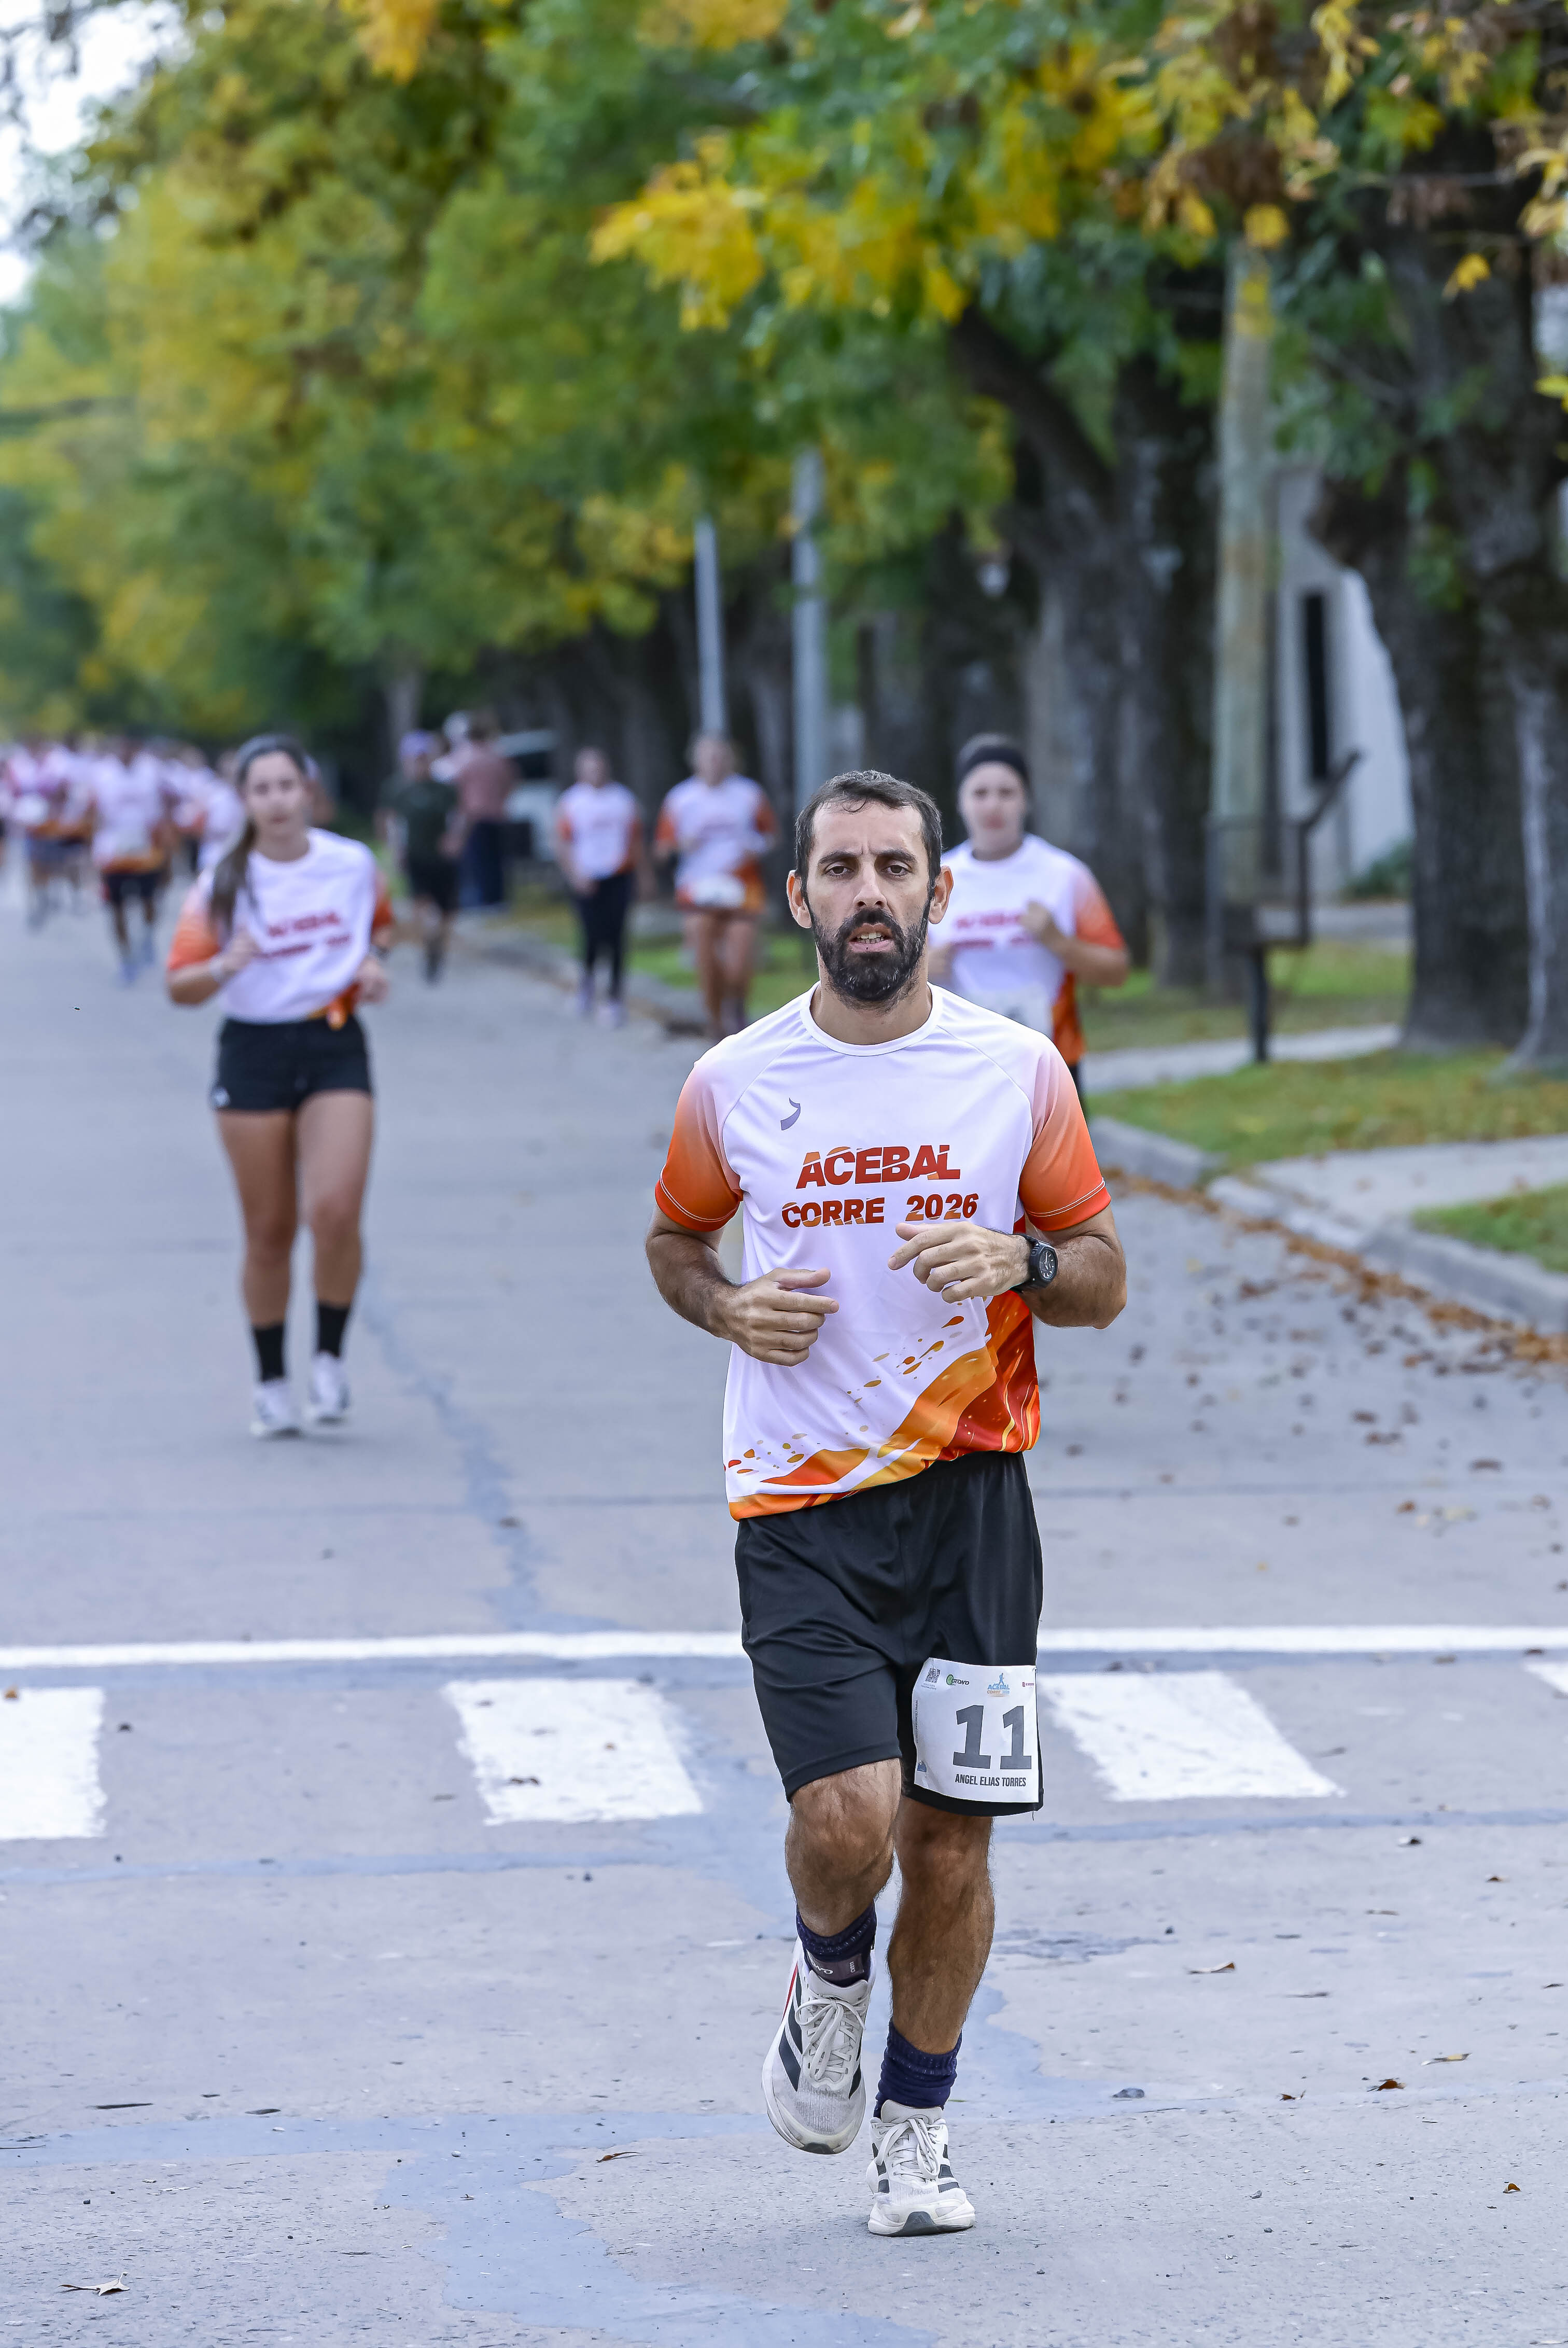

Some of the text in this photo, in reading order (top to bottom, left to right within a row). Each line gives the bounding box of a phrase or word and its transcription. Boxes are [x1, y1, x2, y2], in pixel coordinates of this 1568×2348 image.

[796, 1145, 961, 1189] ACEBAL
[782, 1193, 979, 1228] CORRE 2026
[953, 1705, 1031, 1769] 11
[955, 1773, 1026, 1787] ANGEL ELIAS TORRES
